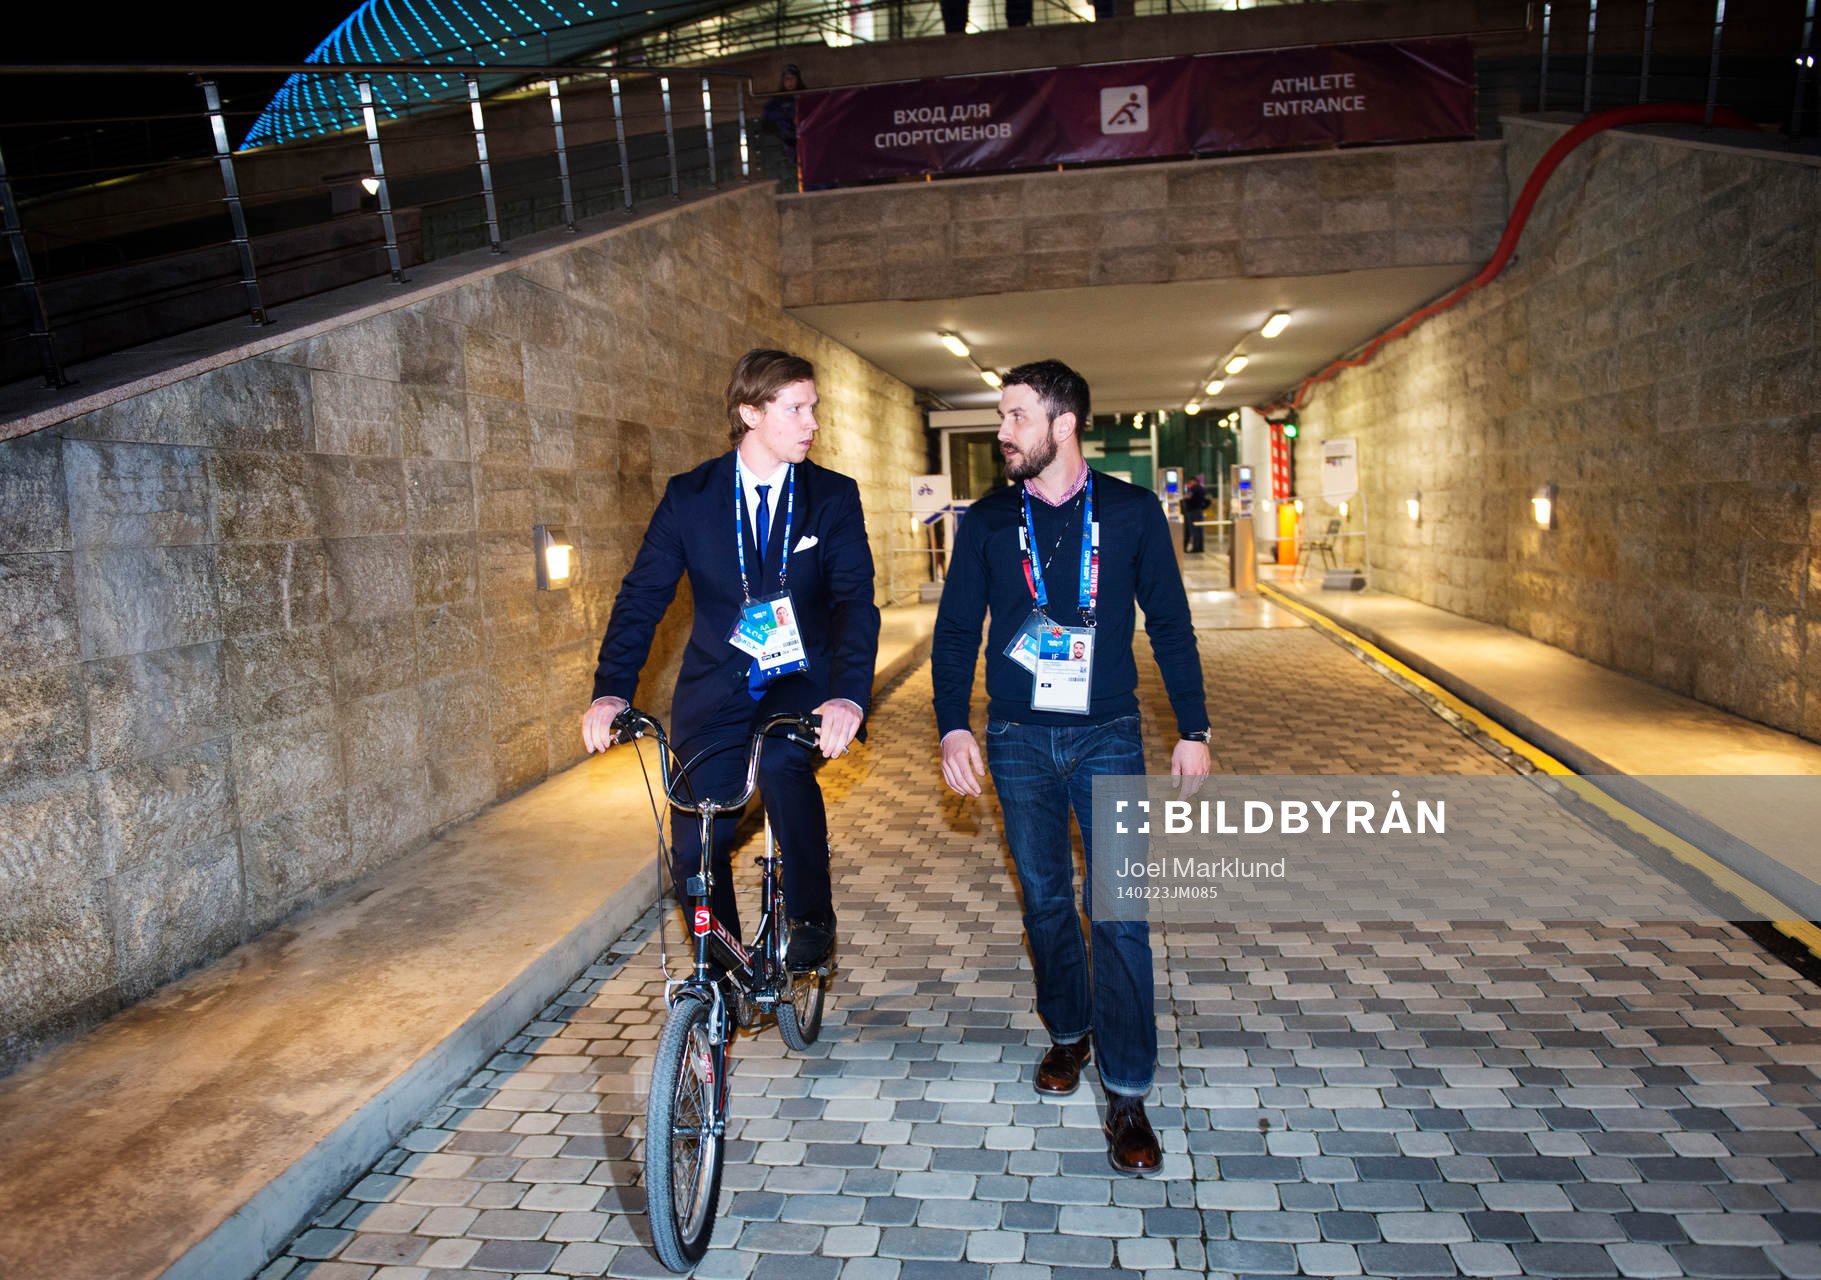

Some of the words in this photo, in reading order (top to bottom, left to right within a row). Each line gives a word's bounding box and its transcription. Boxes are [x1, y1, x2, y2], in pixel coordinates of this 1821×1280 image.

[1271, 73, 1356, 94] ATHLETE
[893, 106, 946, 125] ВХОД
[950, 103, 991, 122] ДЛЯ
[1263, 96, 1366, 117] ENTRANCE
[874, 122, 1013, 148] СПОРТСМЕНОВ
[1090, 564, 1099, 594] CANADA
